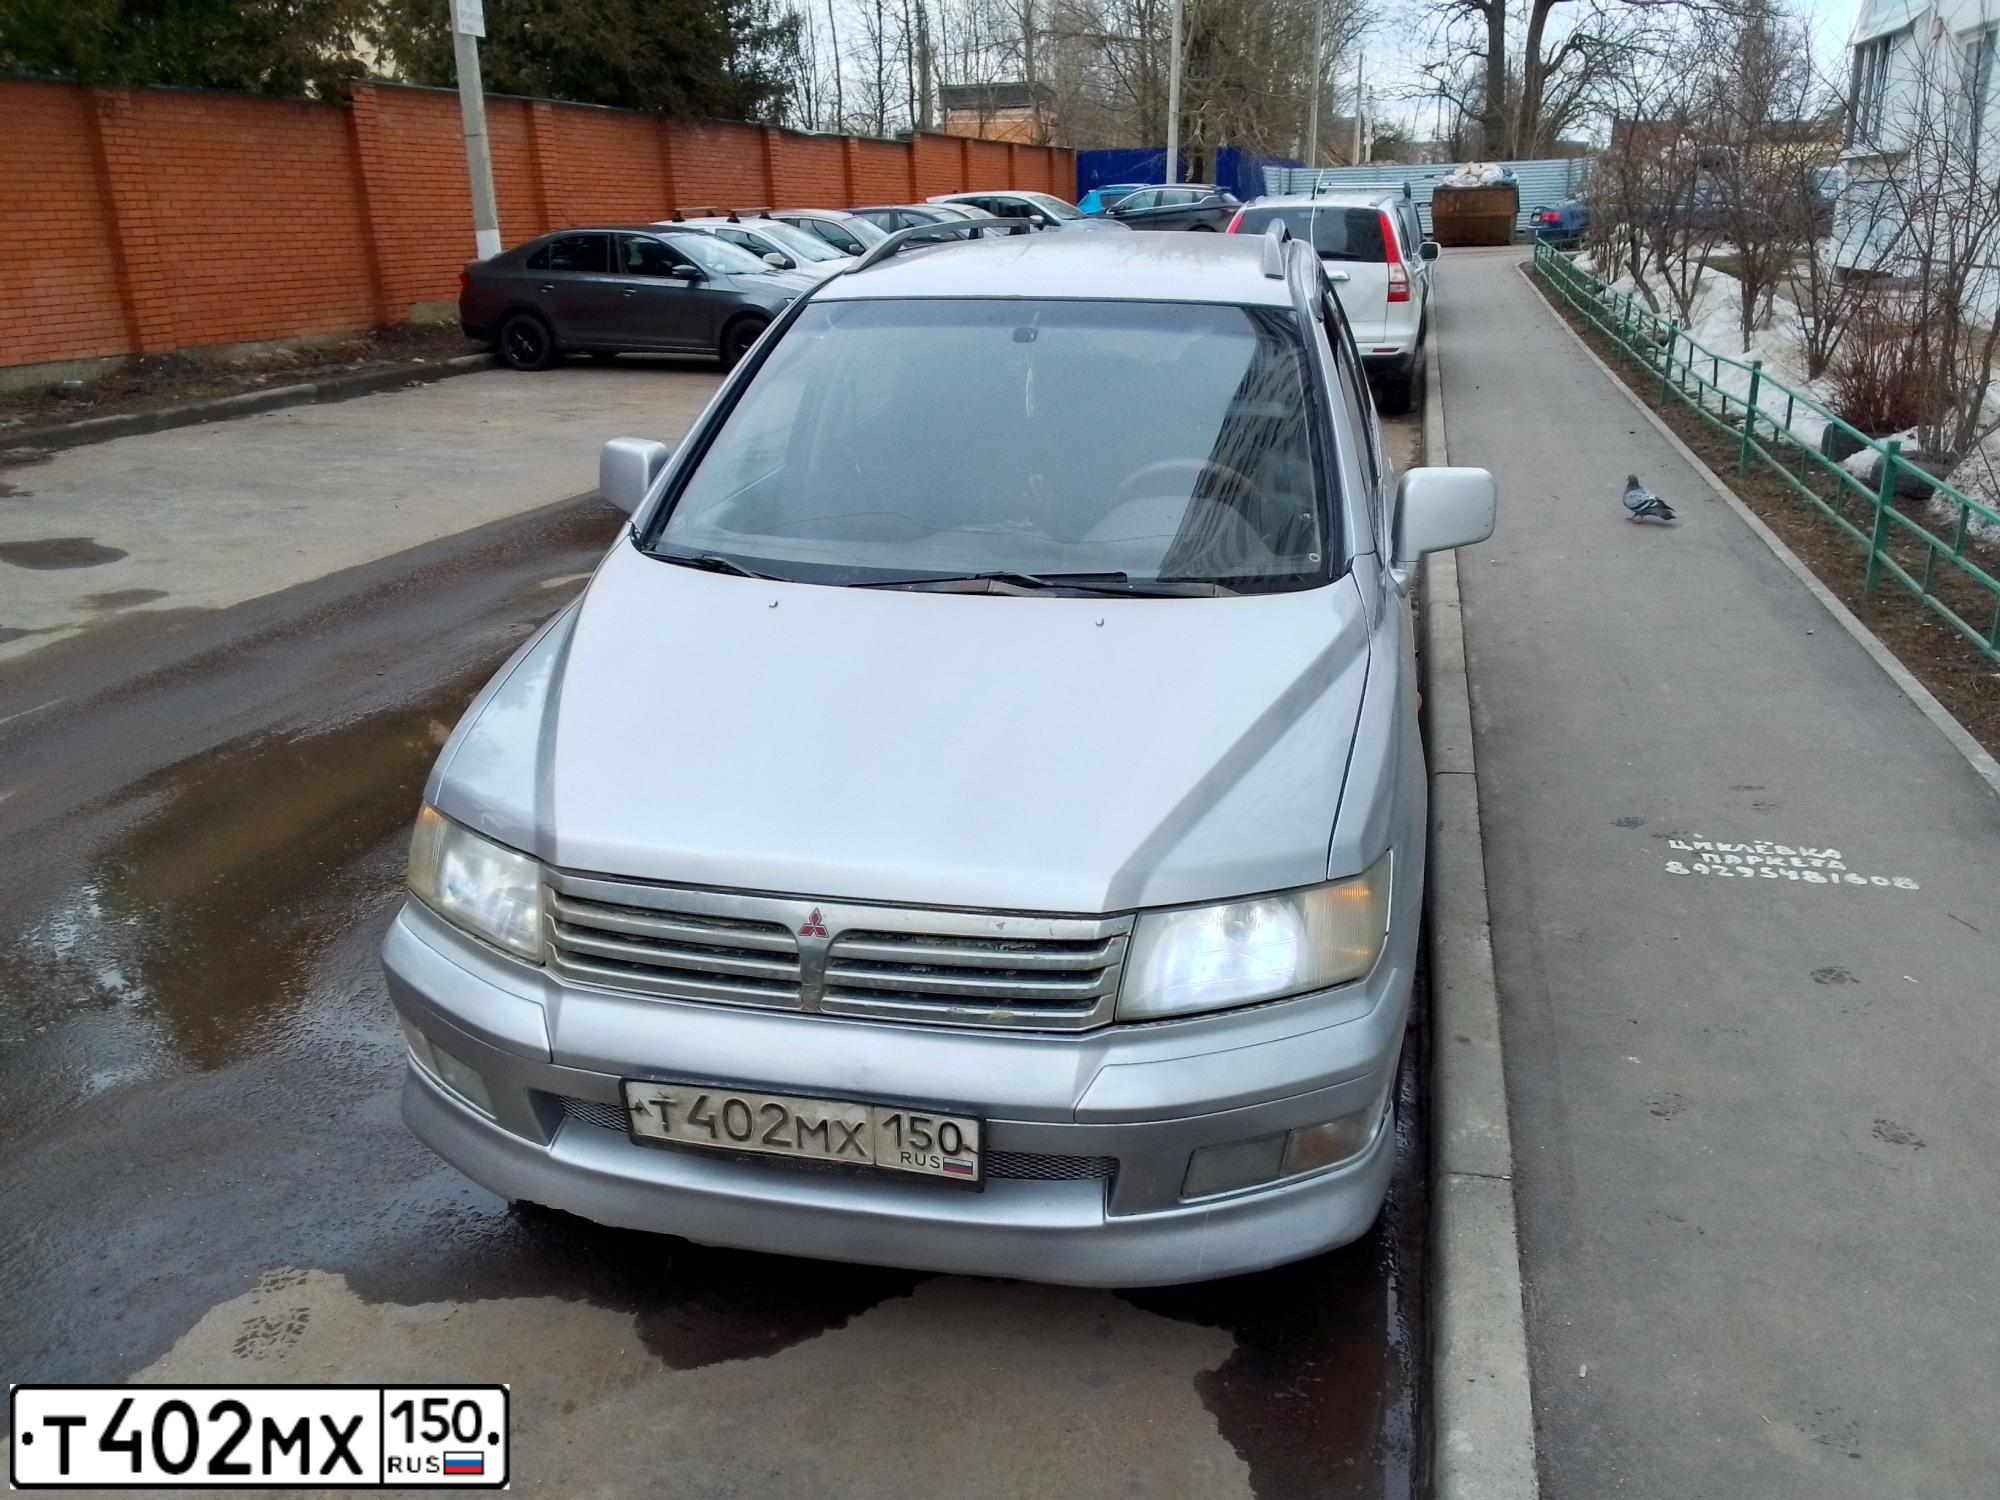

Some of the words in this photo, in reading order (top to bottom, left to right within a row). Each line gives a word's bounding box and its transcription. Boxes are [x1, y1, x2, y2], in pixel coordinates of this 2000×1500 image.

[1701, 852, 1847, 871] ПАРКЕТА
[882, 1112, 964, 1156] 150
[900, 1151, 941, 1169] RUS
